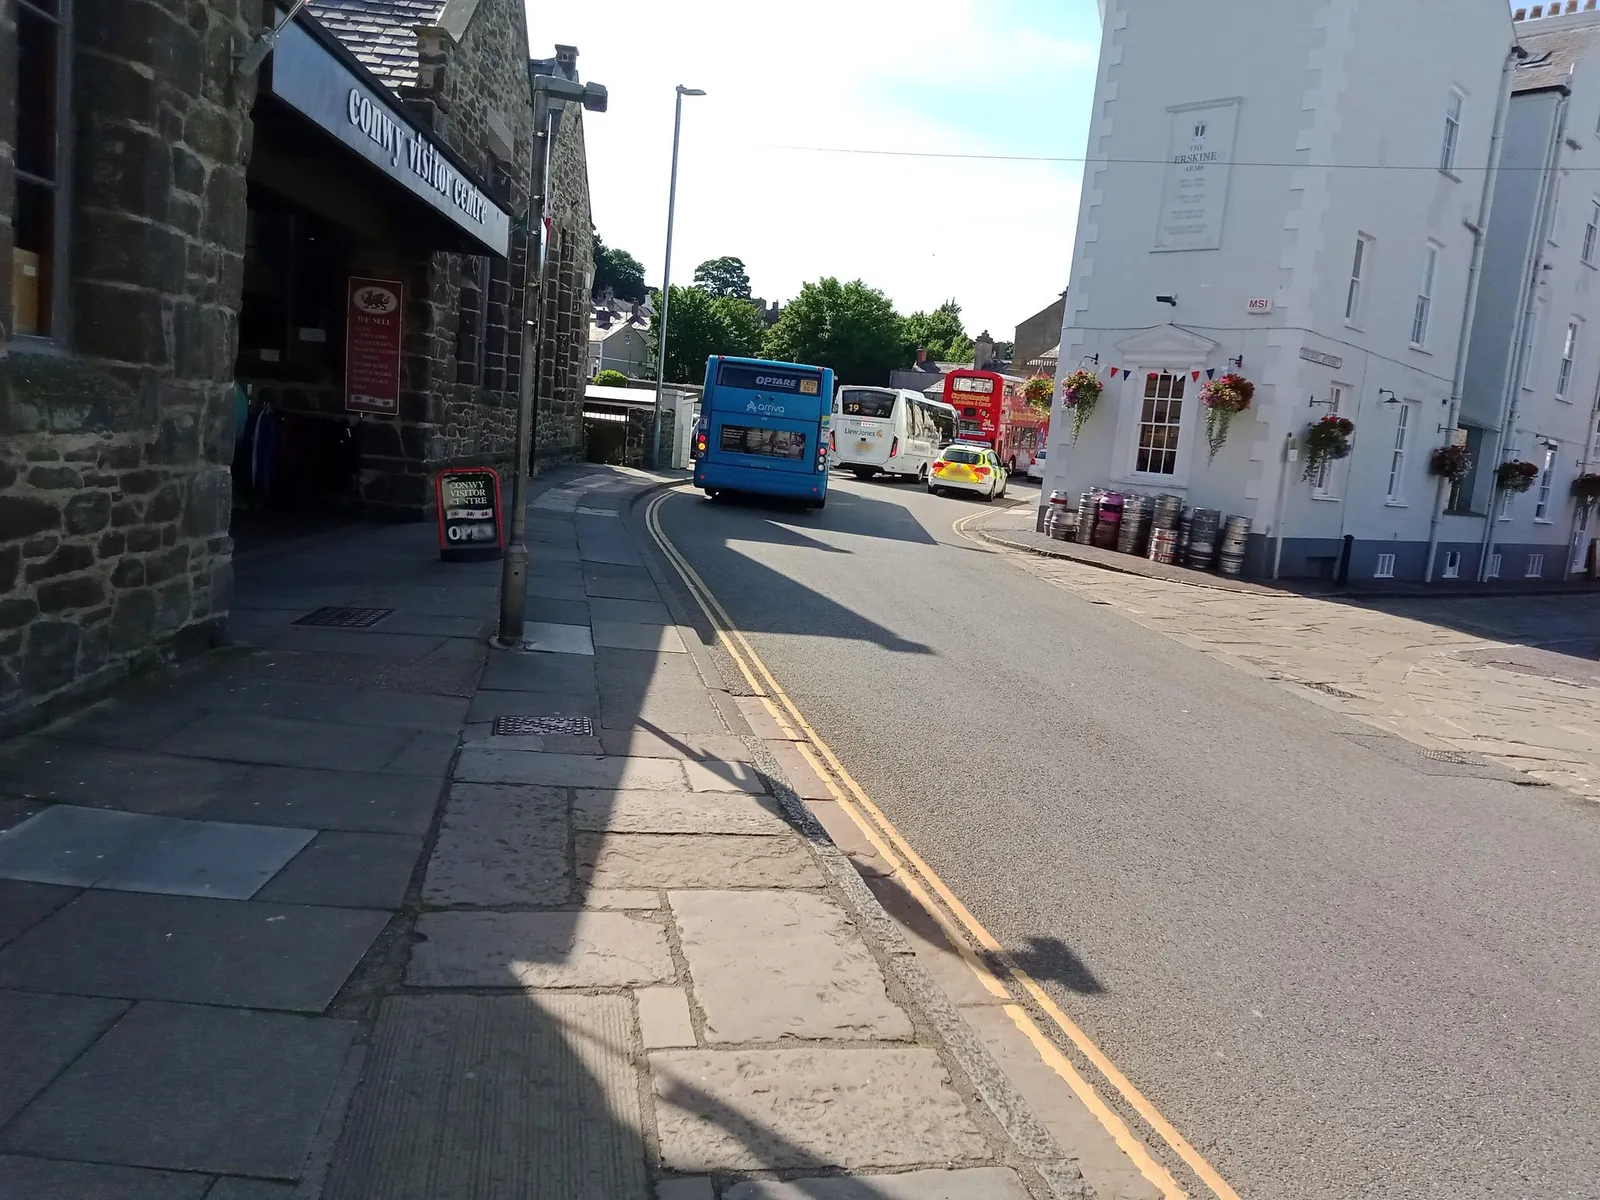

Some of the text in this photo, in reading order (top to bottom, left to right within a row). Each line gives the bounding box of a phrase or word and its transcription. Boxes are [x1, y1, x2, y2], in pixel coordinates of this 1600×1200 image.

[349, 88, 488, 225] conwy visitor centre
[1174, 151, 1217, 164] ERSKINE
[1248, 299, 1269, 309] MSI
[755, 376, 797, 388] OPTARE
[757, 402, 785, 413] arriva
[848, 403, 860, 413] 19
[450, 480, 485, 489] CONWY
[450, 488, 486, 497] VISITOR
[450, 496, 488, 505] CENTRE
